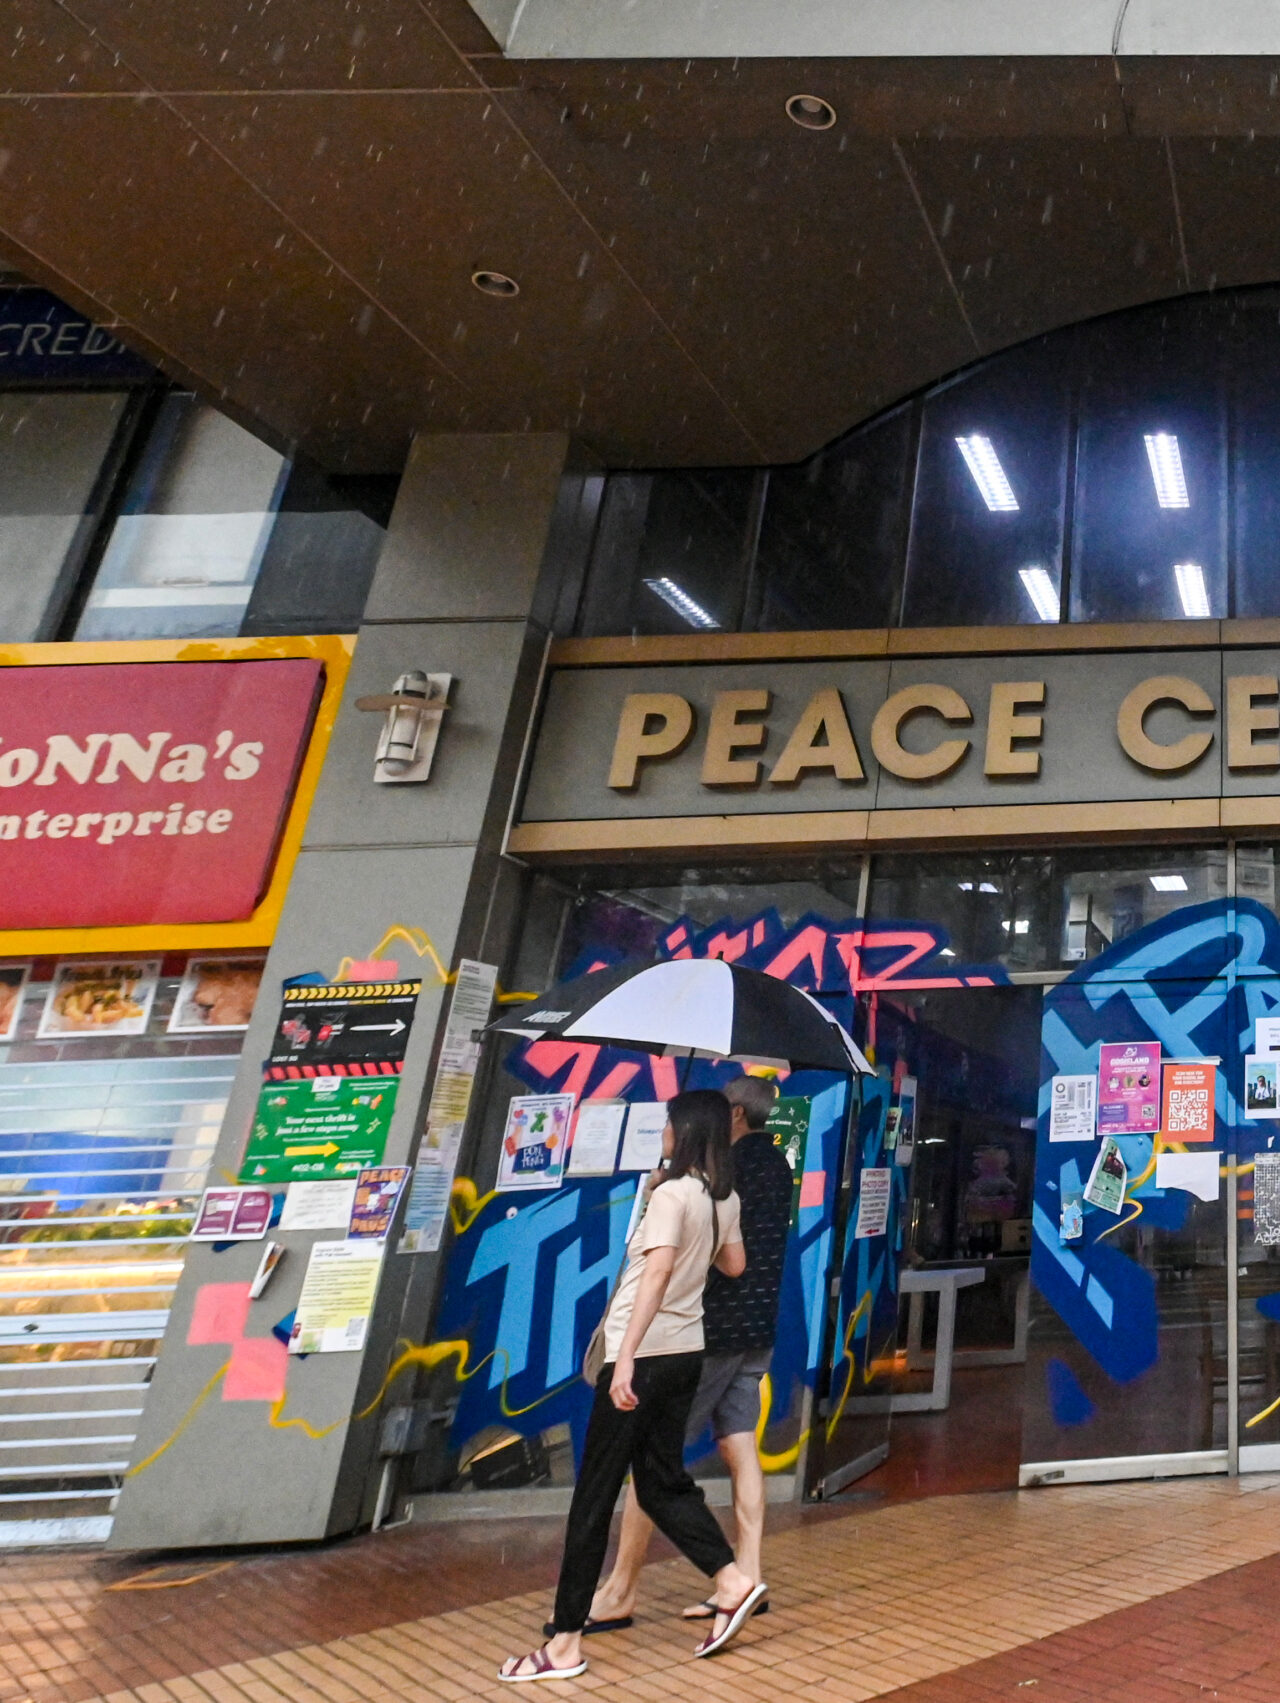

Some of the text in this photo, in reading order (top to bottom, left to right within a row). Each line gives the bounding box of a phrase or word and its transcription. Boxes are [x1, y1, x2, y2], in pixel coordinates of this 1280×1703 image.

[0, 322, 125, 356] CRED
[0, 729, 264, 788] oNNa's
[607, 681, 1046, 788] PEACE
